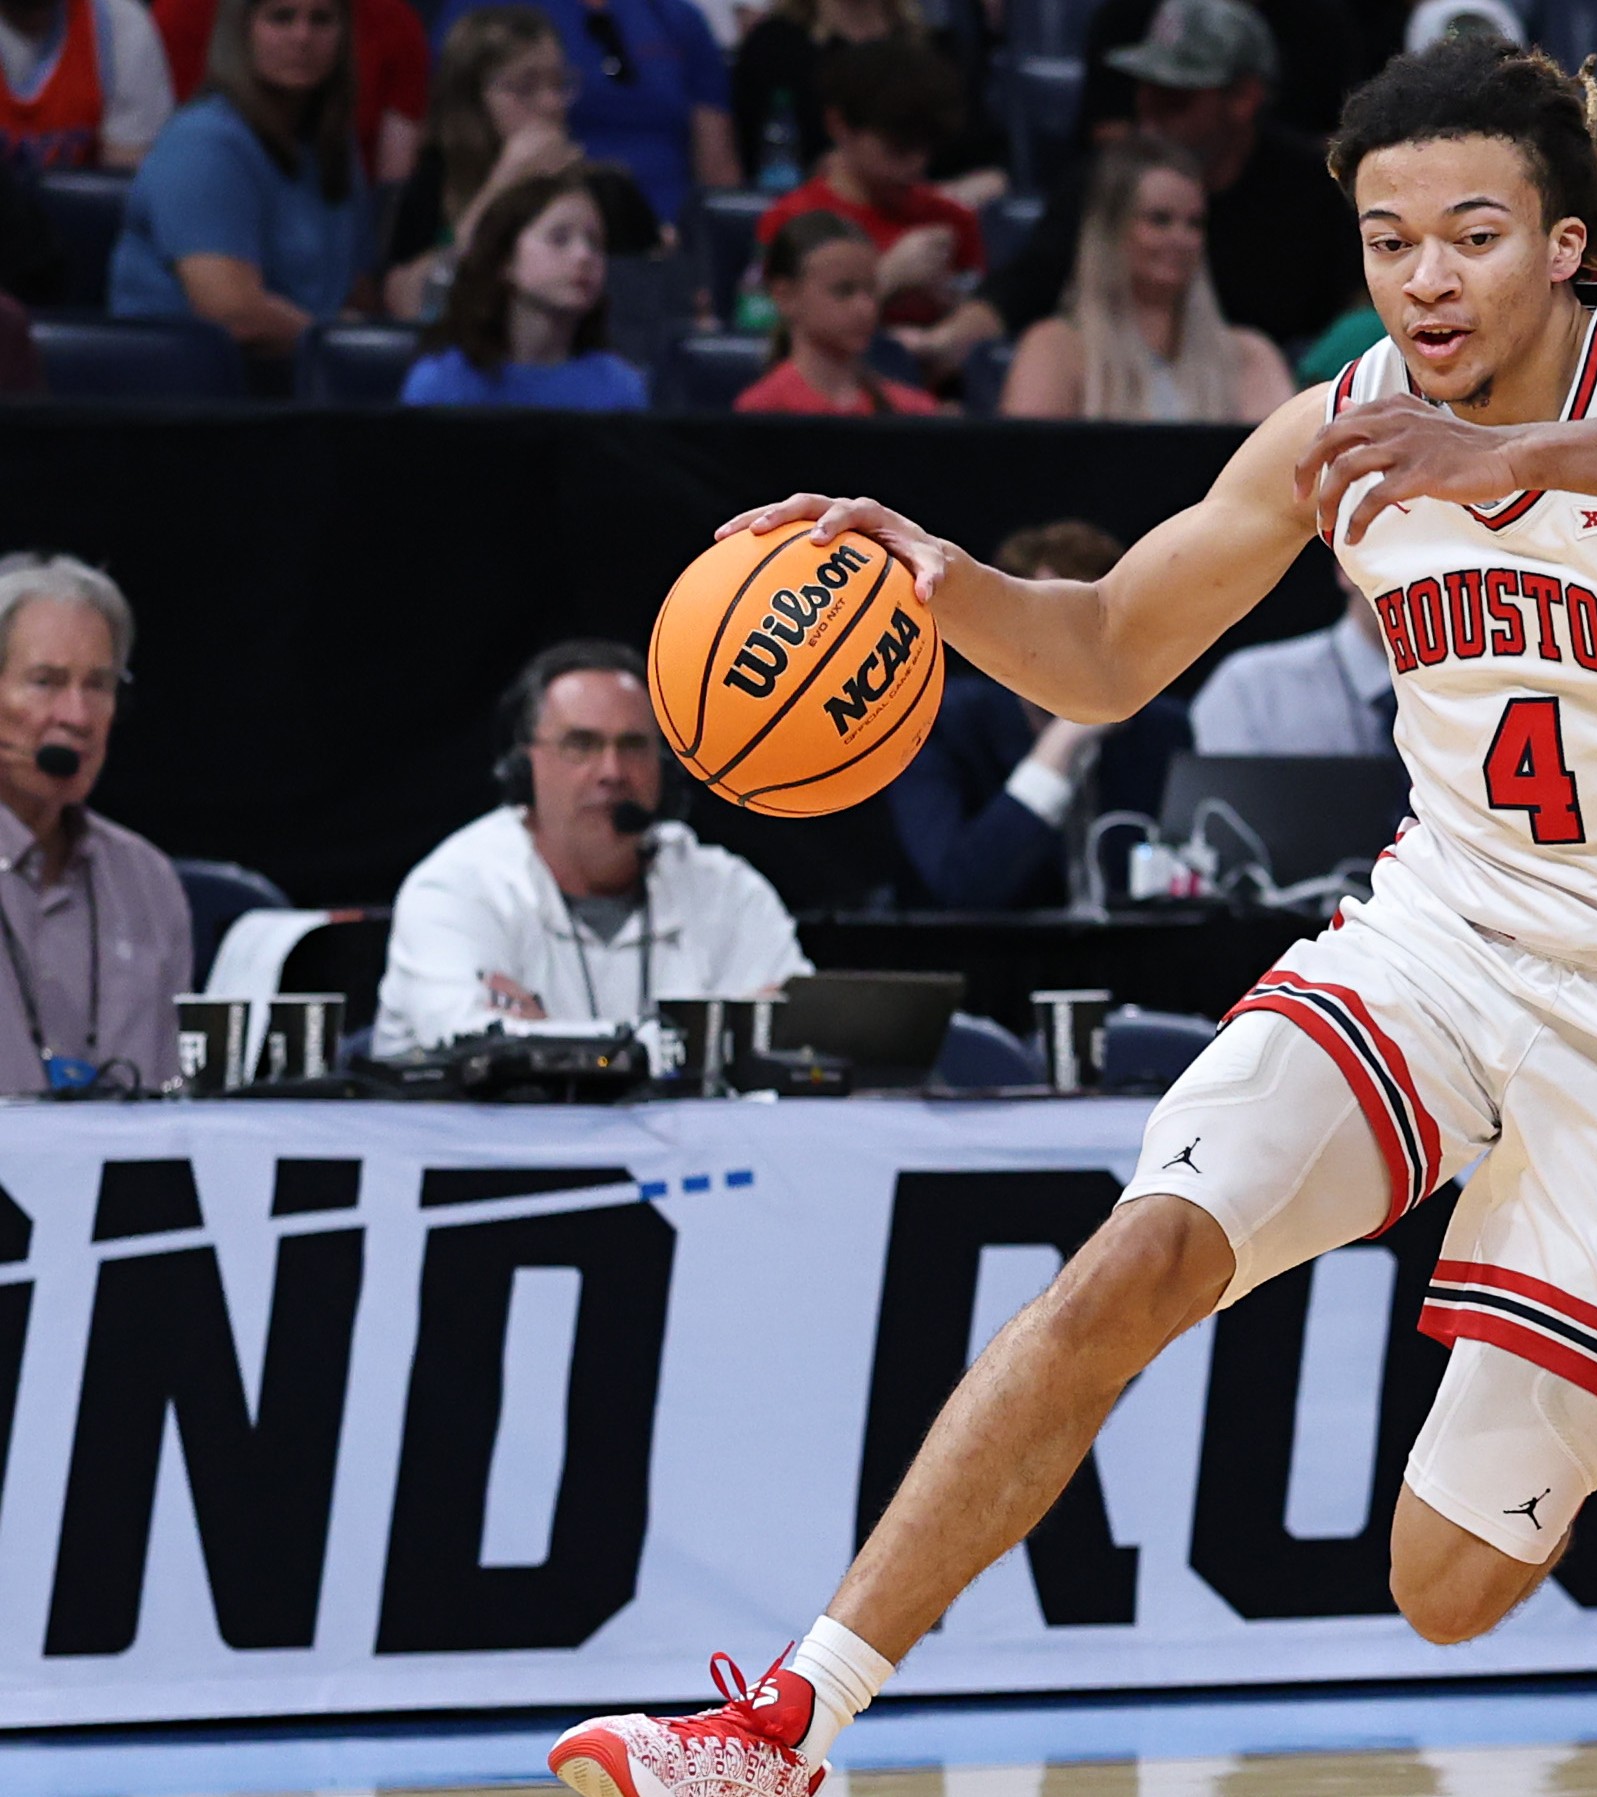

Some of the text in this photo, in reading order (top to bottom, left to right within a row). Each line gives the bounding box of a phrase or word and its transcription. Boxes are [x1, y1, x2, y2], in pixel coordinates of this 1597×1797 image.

[722, 545, 871, 699] Wilson
[808, 597, 847, 648] EVO NXT
[823, 607, 921, 737] NCAA
[1482, 696, 1586, 844] 4
[0, 1157, 679, 1658] ND
